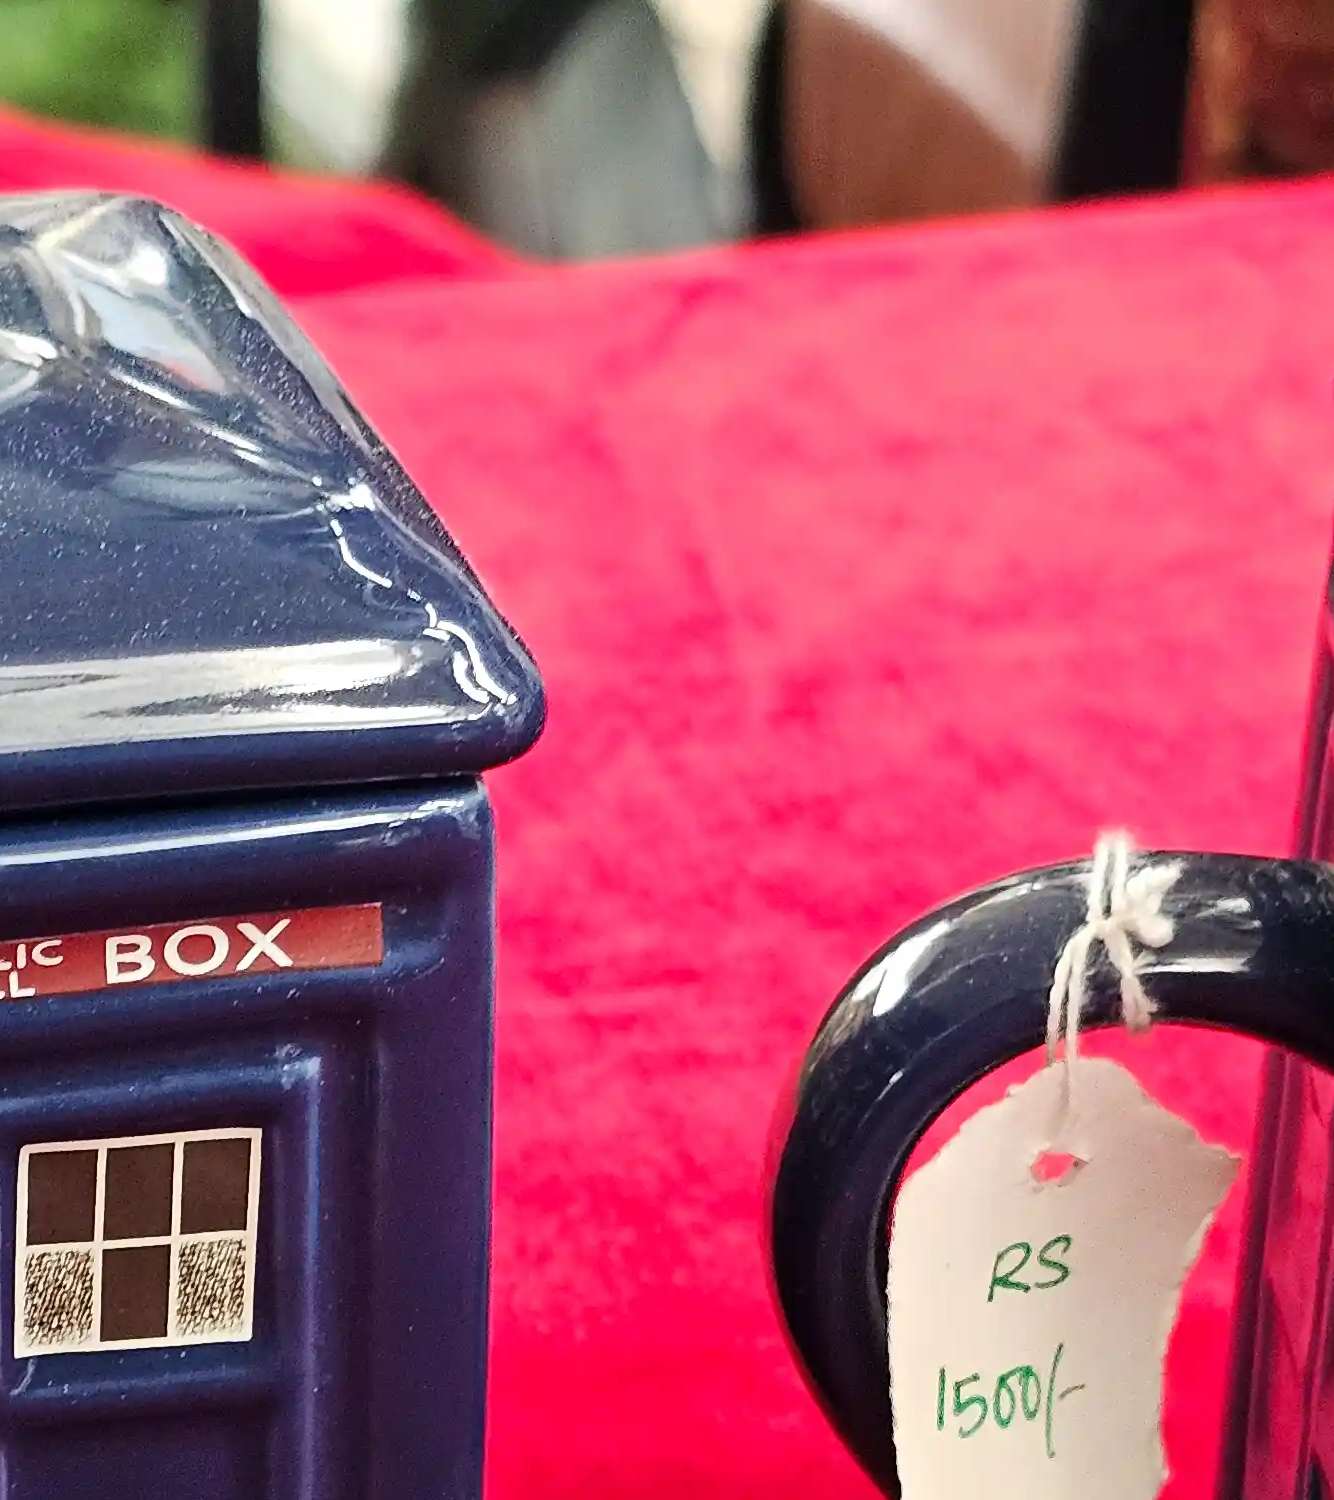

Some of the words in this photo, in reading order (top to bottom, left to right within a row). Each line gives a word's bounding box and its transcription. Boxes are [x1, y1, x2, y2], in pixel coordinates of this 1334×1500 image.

[103, 918, 294, 983] BOX
[987, 1234, 1073, 1302] RS
[936, 1342, 1086, 1459] 1500/-
